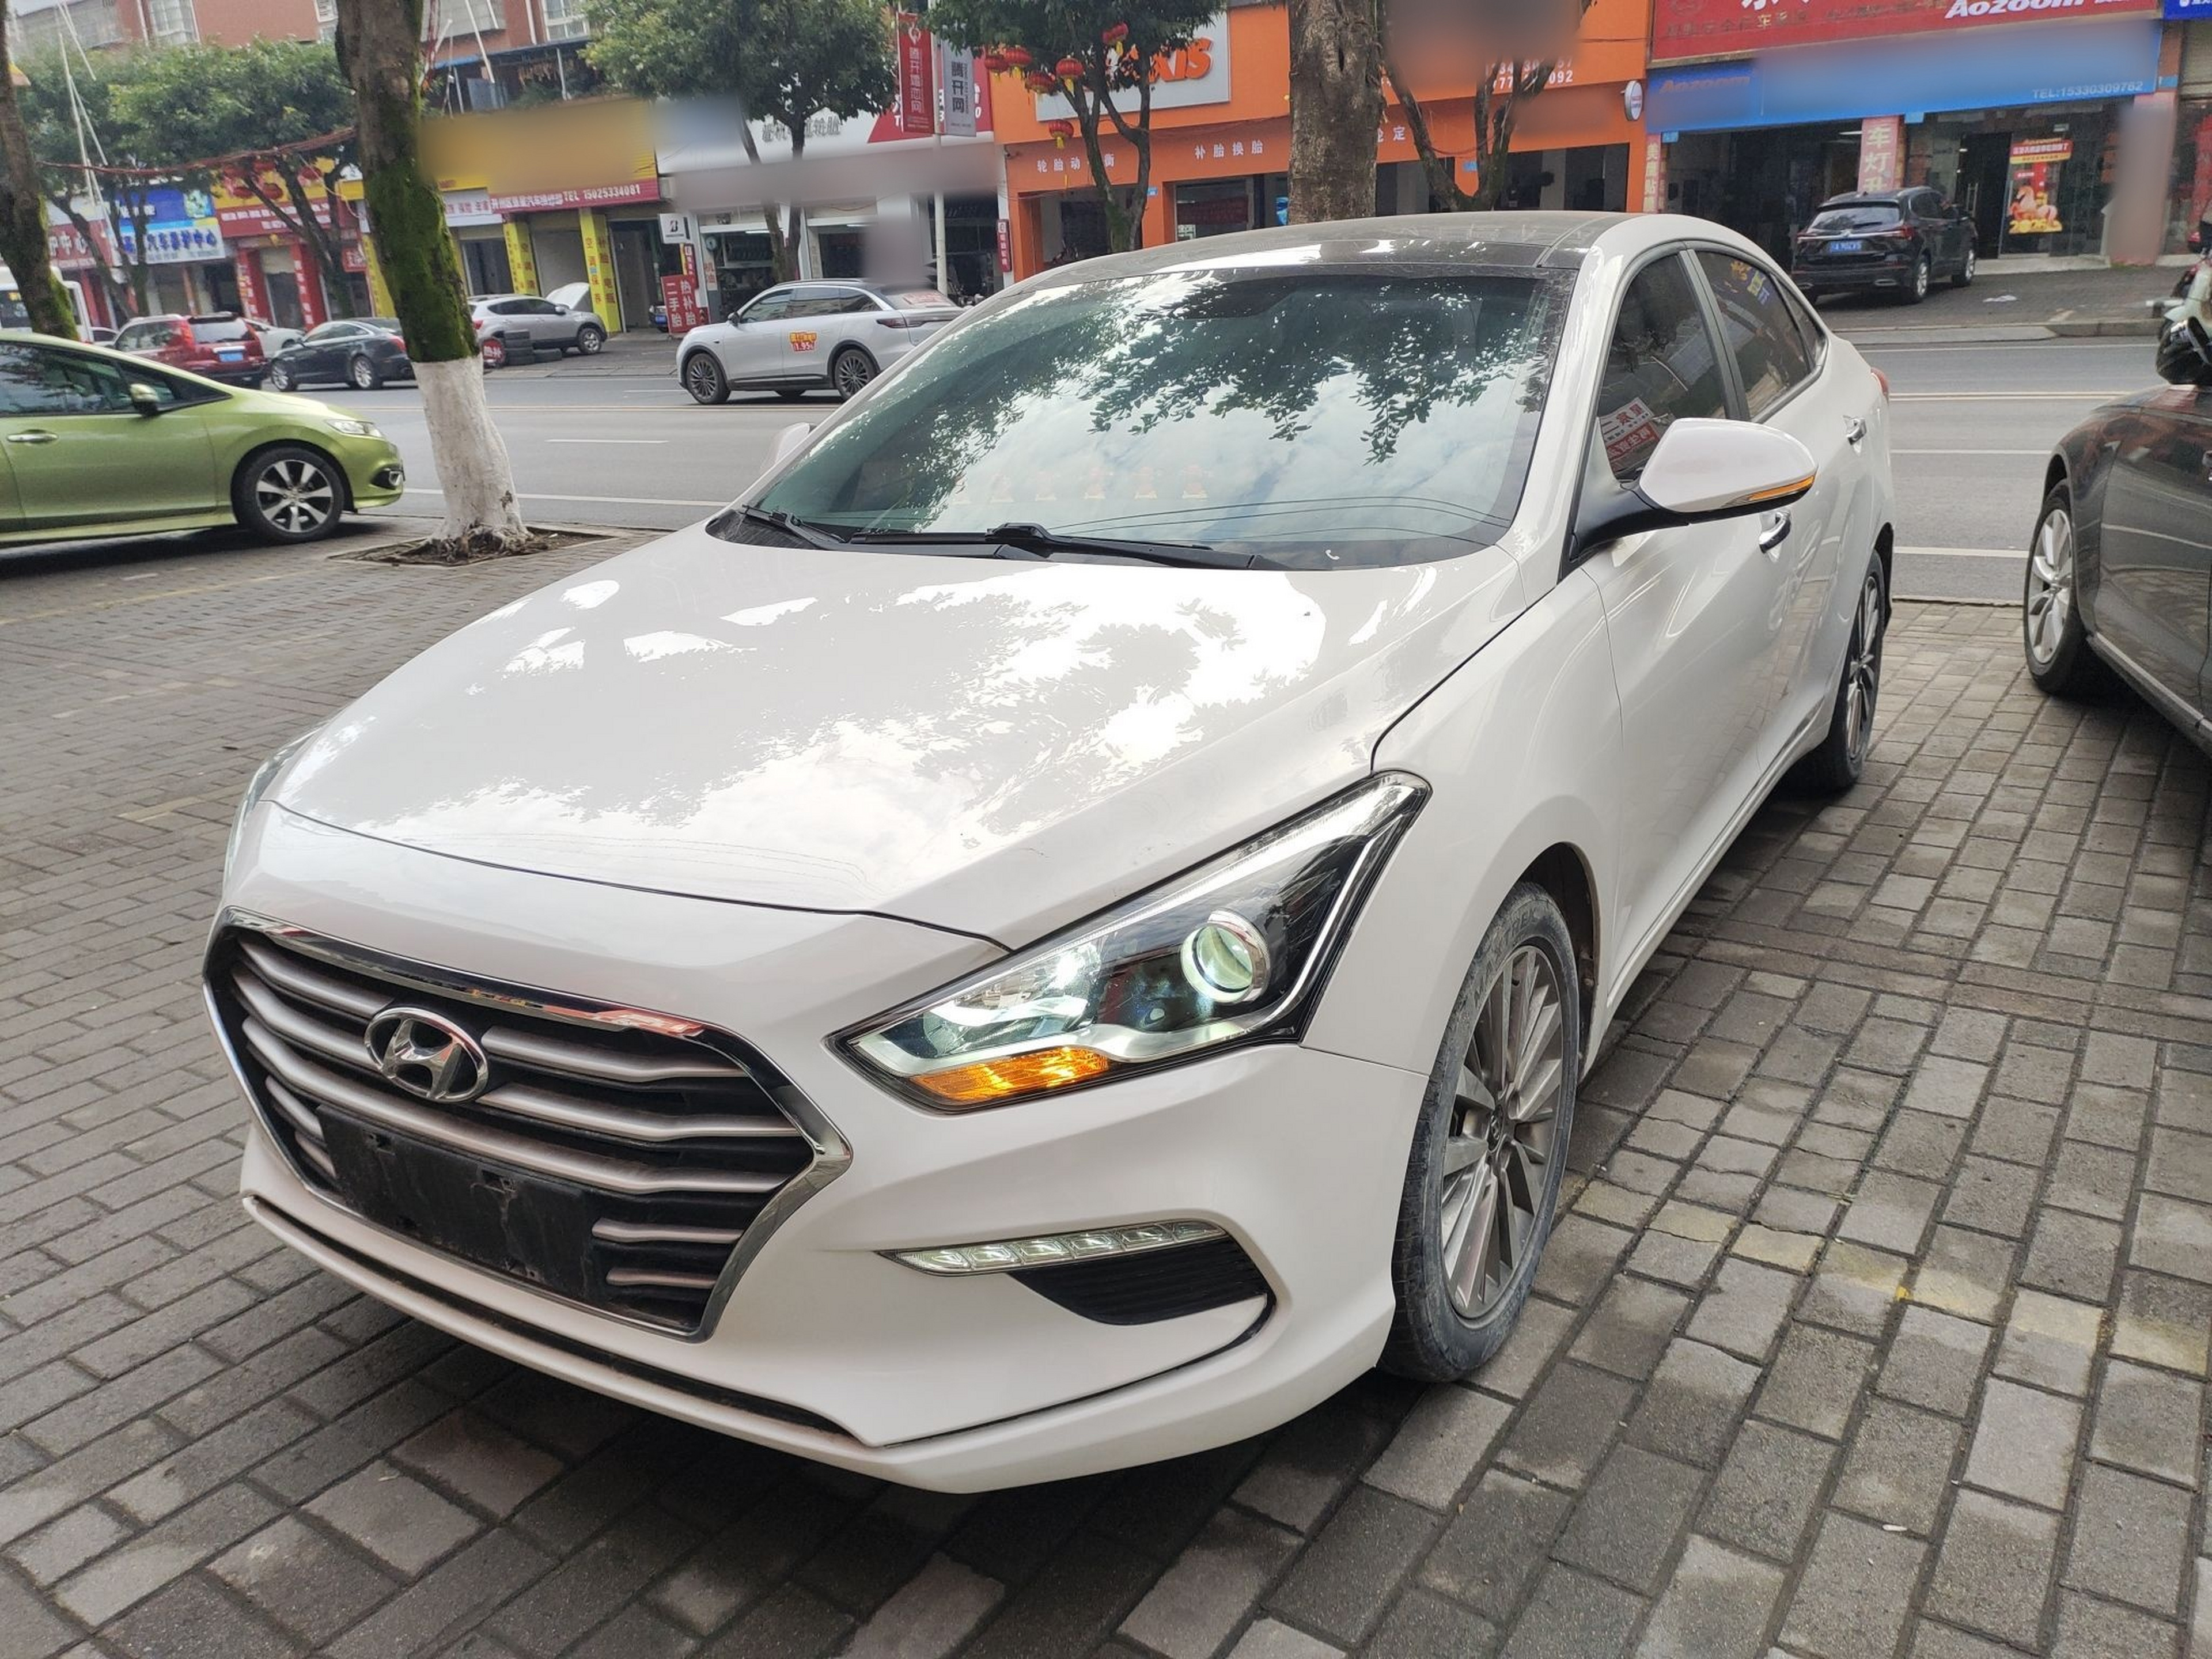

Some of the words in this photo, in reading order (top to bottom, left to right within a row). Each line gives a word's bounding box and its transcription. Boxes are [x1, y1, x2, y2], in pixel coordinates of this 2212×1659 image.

[1195, 140, 1263, 159] 补胎换胎
[1037, 154, 1115, 172] 轮胎动衡
